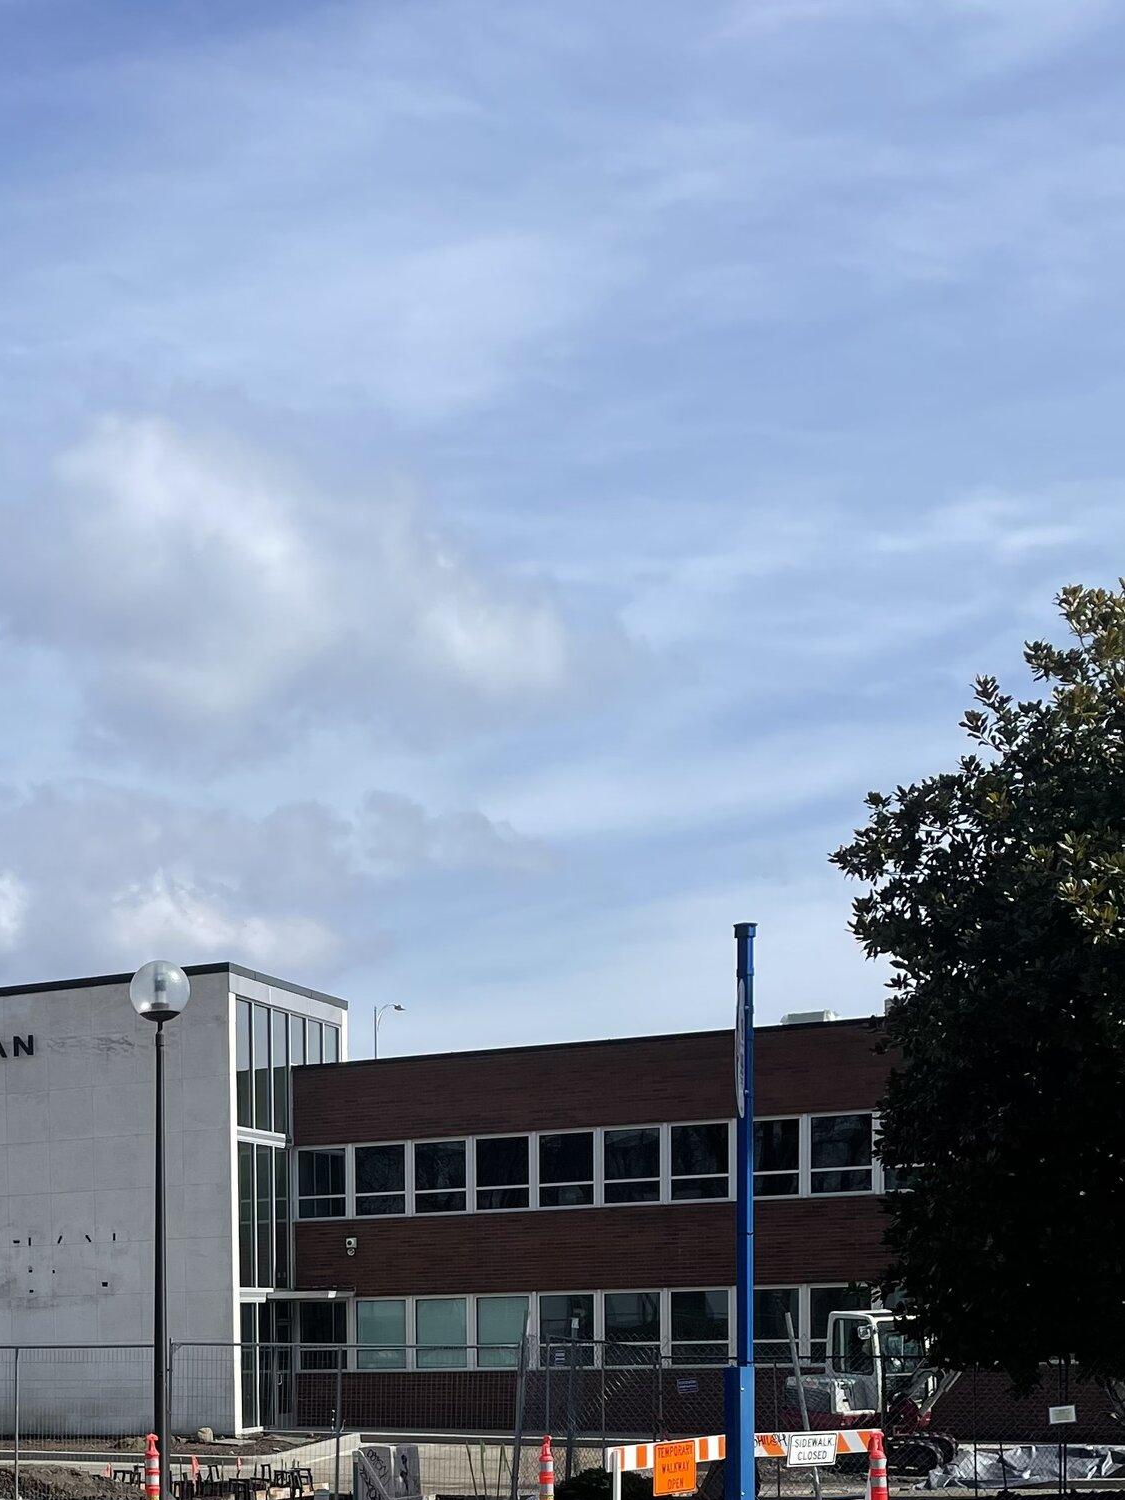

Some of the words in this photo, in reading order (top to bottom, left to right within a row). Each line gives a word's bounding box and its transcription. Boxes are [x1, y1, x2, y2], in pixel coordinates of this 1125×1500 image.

[794, 1437, 833, 1448] SIDEWALK
[658, 1444, 693, 1459] TEMPORARY
[797, 1450, 828, 1461] CLOSED
[661, 1460, 690, 1474] WALKWAY
[667, 1477, 684, 1489] OPEN
